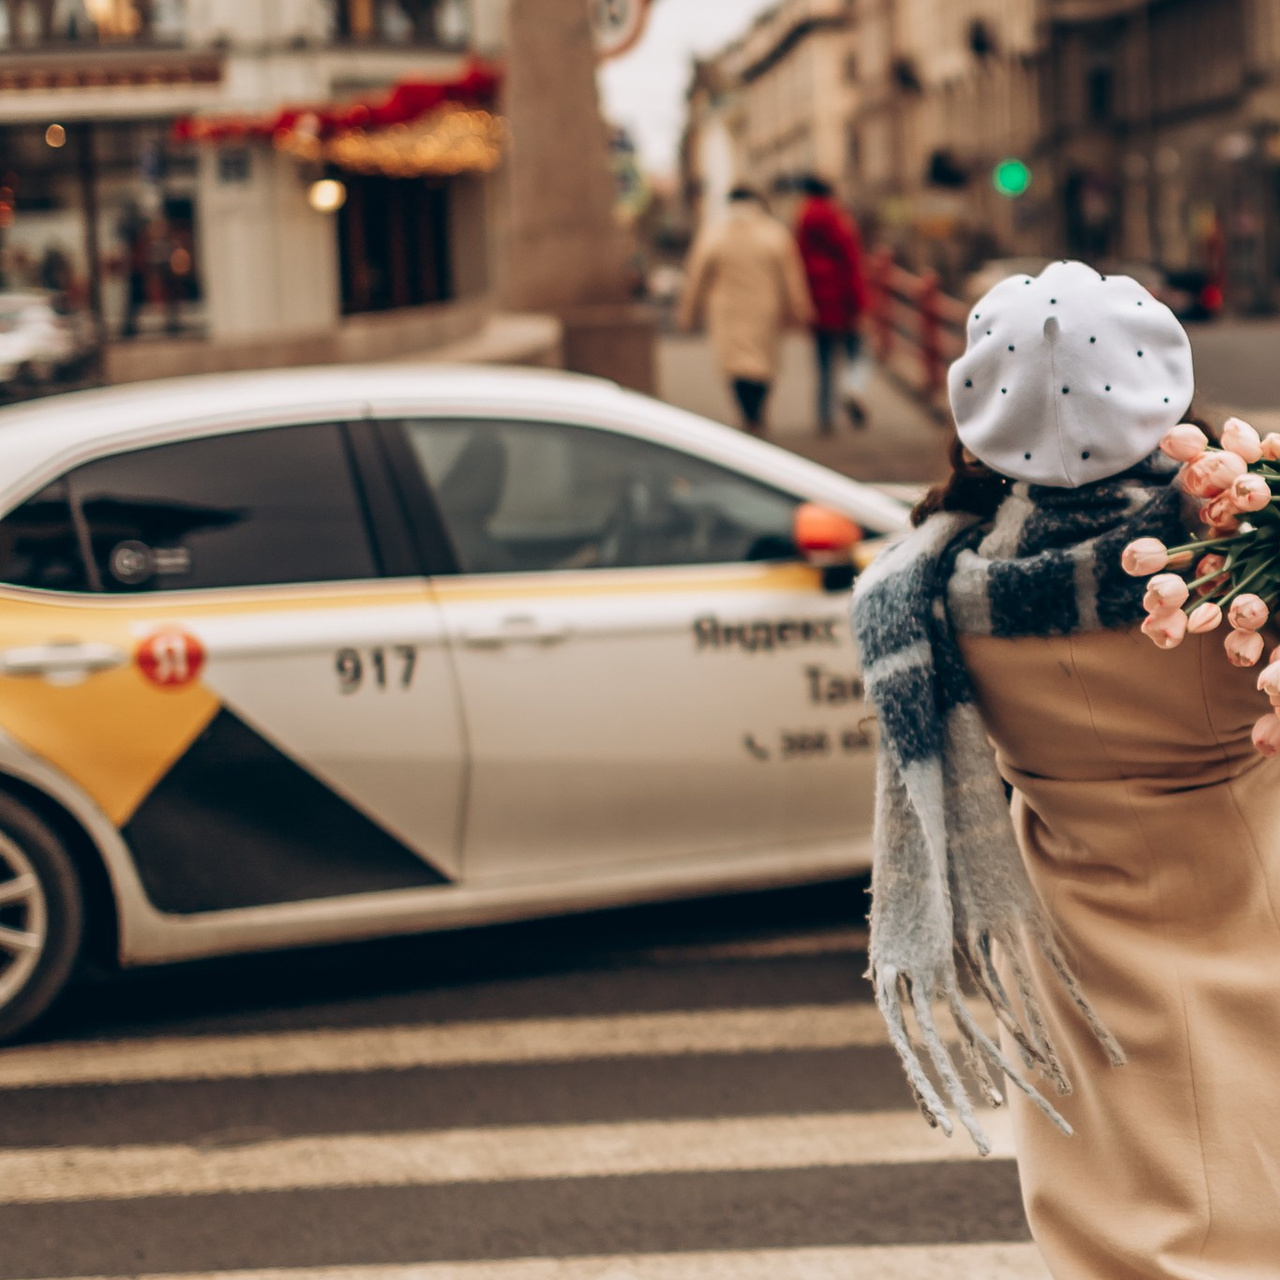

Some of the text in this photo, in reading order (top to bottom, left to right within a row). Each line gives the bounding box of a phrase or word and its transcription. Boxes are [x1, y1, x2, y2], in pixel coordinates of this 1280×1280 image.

[694, 614, 840, 651] Яндекс
[335, 643, 417, 695] 917
[806, 664, 866, 704] Так
